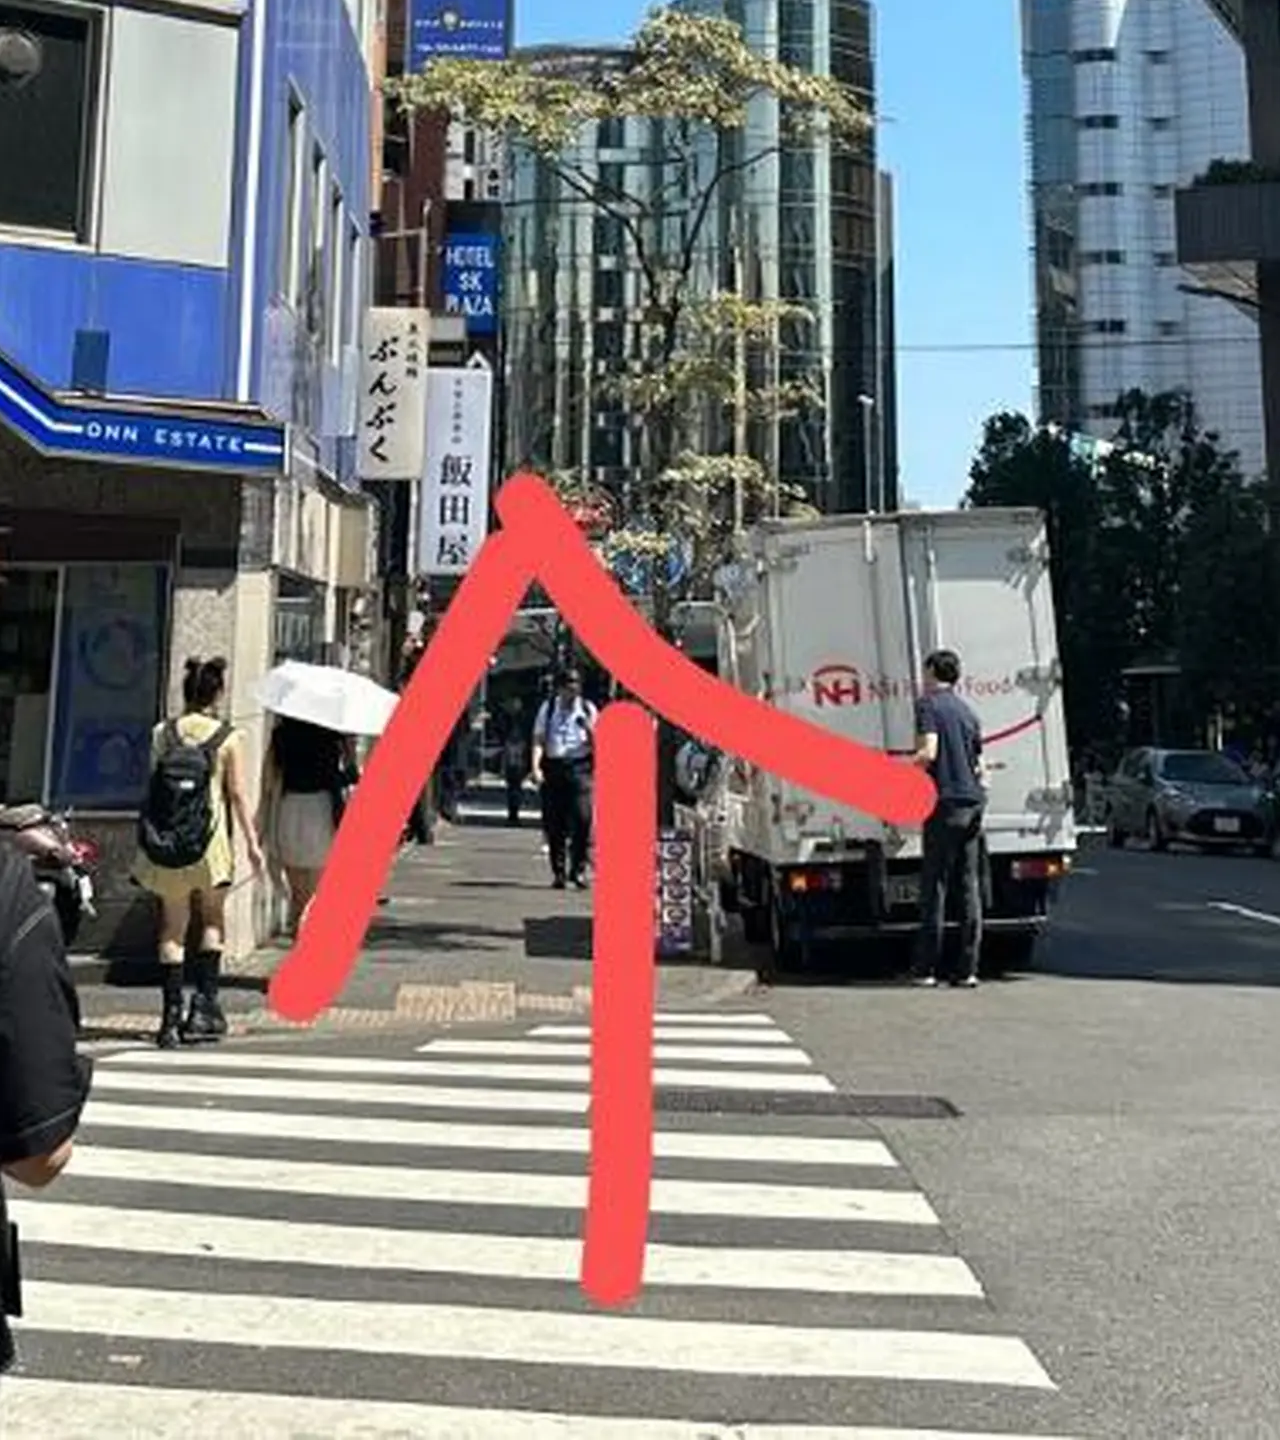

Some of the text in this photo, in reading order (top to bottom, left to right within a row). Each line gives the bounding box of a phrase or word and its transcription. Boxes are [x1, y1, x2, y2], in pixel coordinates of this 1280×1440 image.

[446, 246, 494, 268] HOTEL
[365, 336, 400, 463] ぶんぶく
[86, 421, 243, 453] ONN ESTATE
[437, 453, 473, 566] 飯田屋
[813, 677, 862, 707] NH
